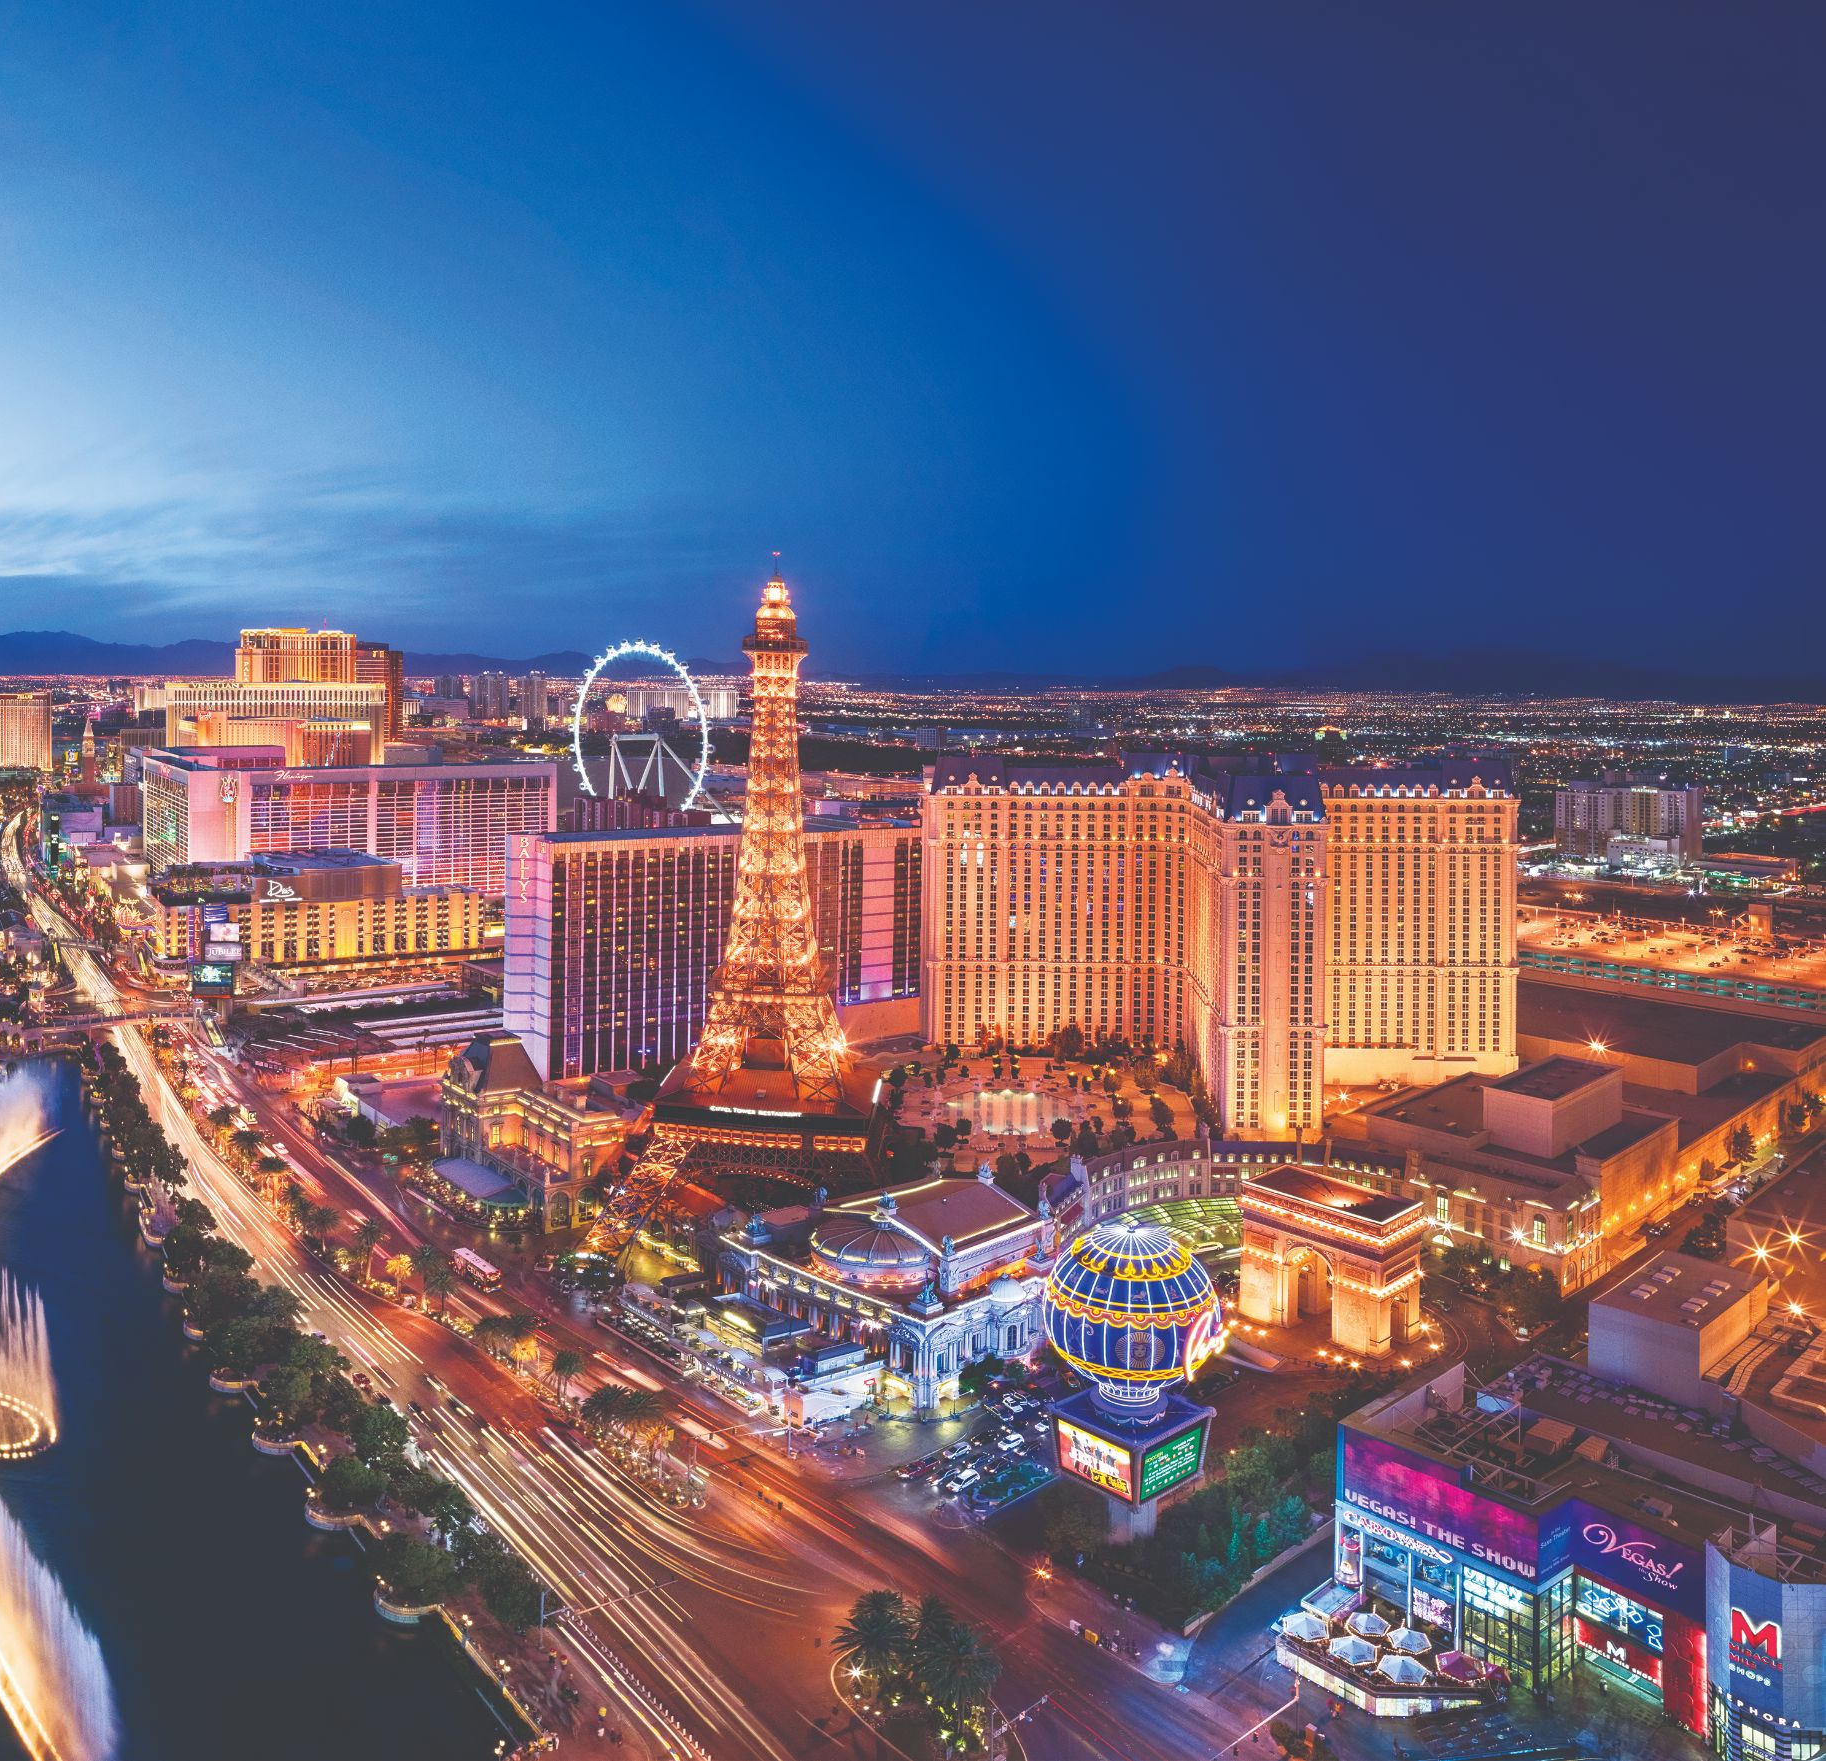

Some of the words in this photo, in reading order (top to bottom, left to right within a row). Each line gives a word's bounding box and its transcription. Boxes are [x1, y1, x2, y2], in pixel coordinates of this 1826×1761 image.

[274, 770, 314, 782] Flamingo
[733, 1107, 756, 1115] TOWER
[757, 1109, 802, 1118] RESTAURANT
[1186, 1311, 1230, 1382] Paris
[1343, 1511, 1398, 1541] CABO
[1344, 1488, 1417, 1529] VEGAS!
[1422, 1520, 1465, 1551] THE
[1471, 1542, 1536, 1579] SHOW
[1643, 1571, 1678, 1590] Show
[1730, 1606, 1782, 1660] M
[1577, 1640, 1611, 1659] MIRACLE
[1606, 1640, 1627, 1661] M
[1728, 1642, 1784, 1672] MIRACLE
[1728, 1652, 1757, 1671] MILE
[1728, 1662, 1772, 1687] SHOPS
[1717, 1685, 1801, 1729] SEPHORA
